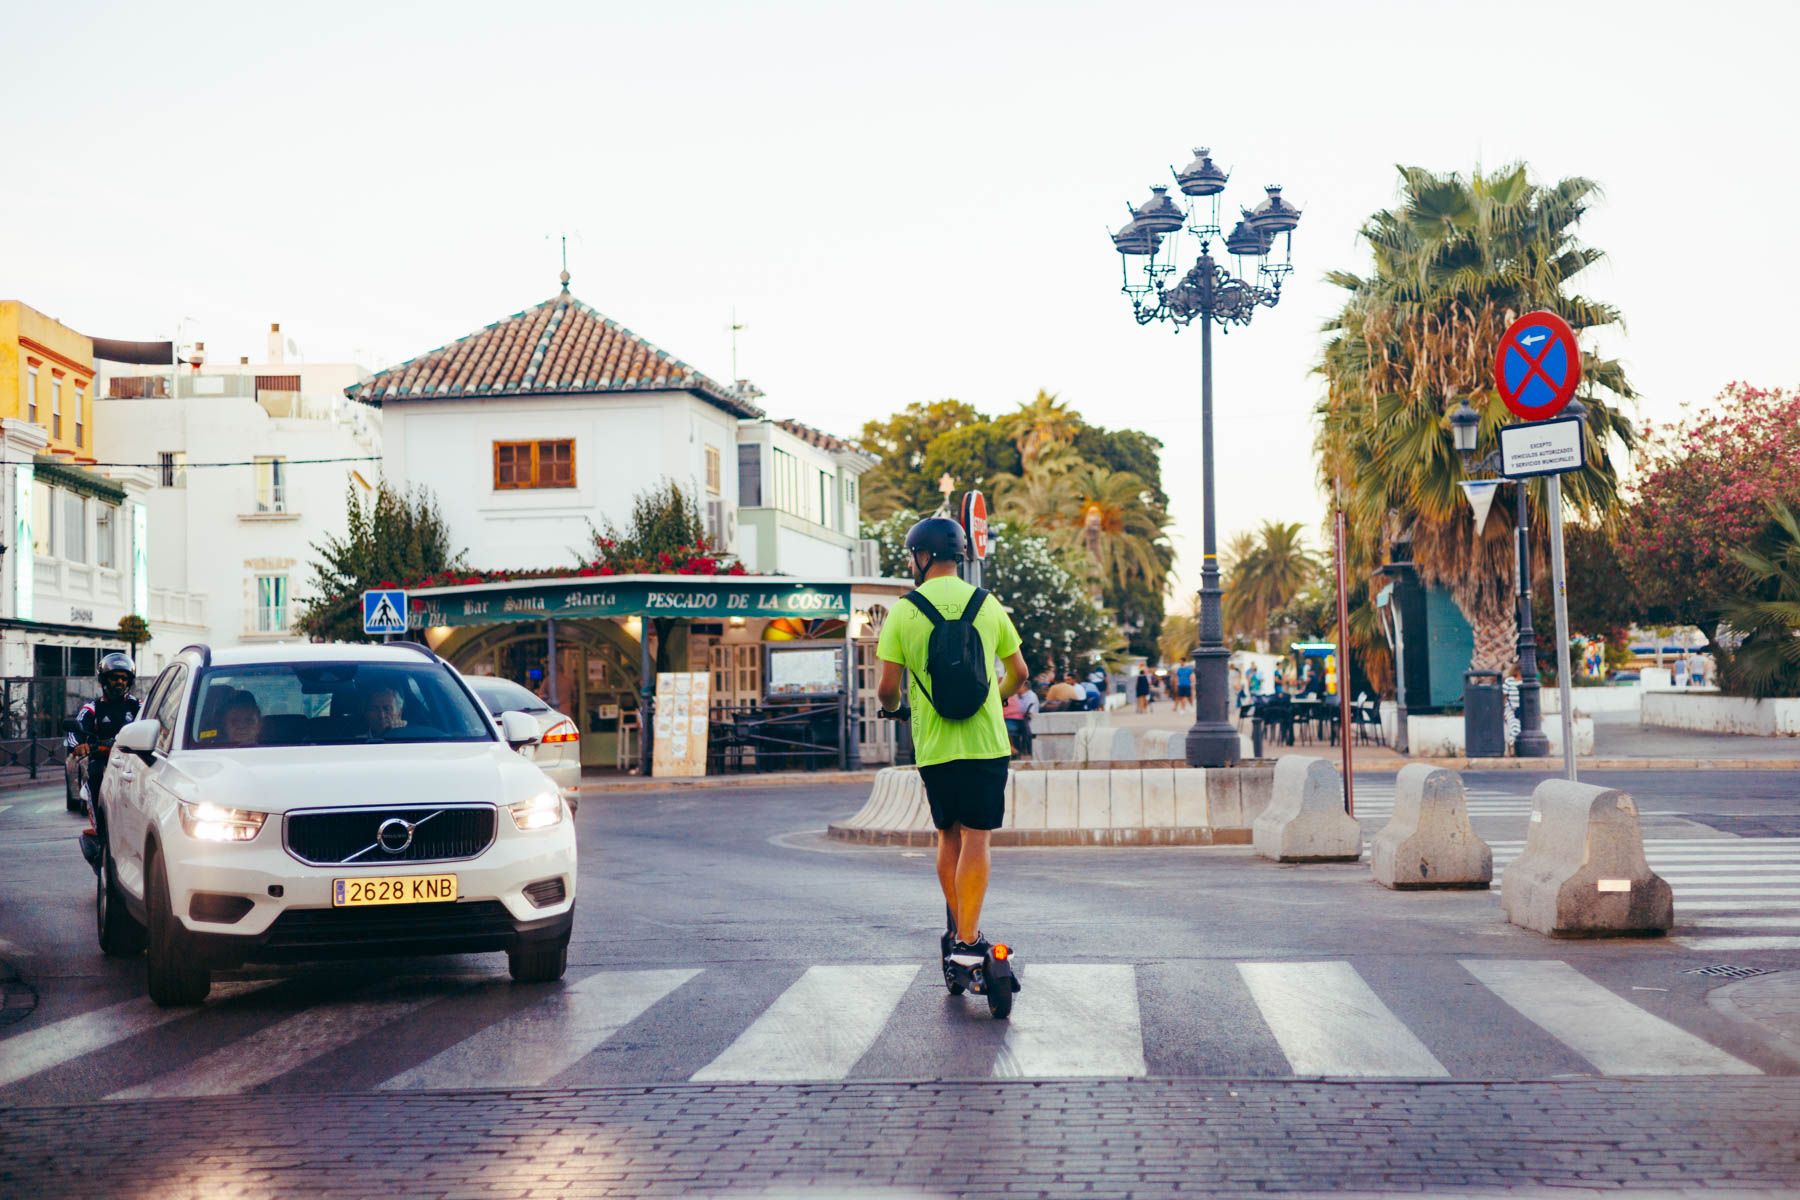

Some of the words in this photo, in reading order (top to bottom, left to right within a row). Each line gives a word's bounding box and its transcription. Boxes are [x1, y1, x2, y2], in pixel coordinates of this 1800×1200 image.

[463, 600, 489, 616] Bar
[503, 596, 545, 611] Santa
[646, 592, 718, 609] PESCADO
[727, 594, 750, 609] DE
[757, 594, 780, 609] LA
[788, 594, 845, 610] COSTA
[350, 881, 404, 901] 2628
[412, 879, 452, 898] KNB
